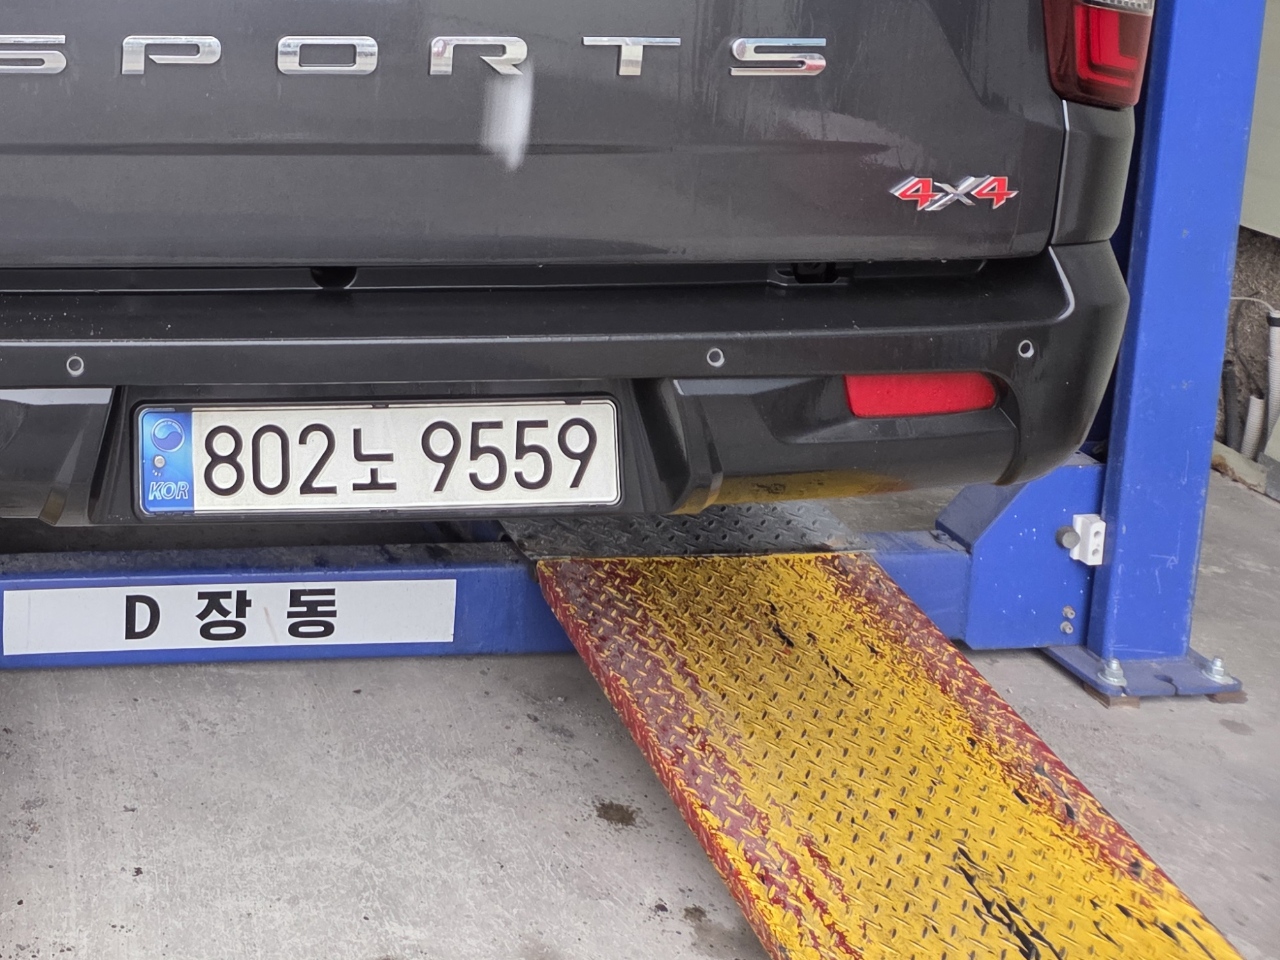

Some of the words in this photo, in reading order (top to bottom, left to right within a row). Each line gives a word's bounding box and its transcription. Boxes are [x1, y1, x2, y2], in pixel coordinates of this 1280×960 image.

[203, 423, 397, 496] 802노
[421, 417, 598, 492] 9559
[148, 480, 190, 501] KOR
